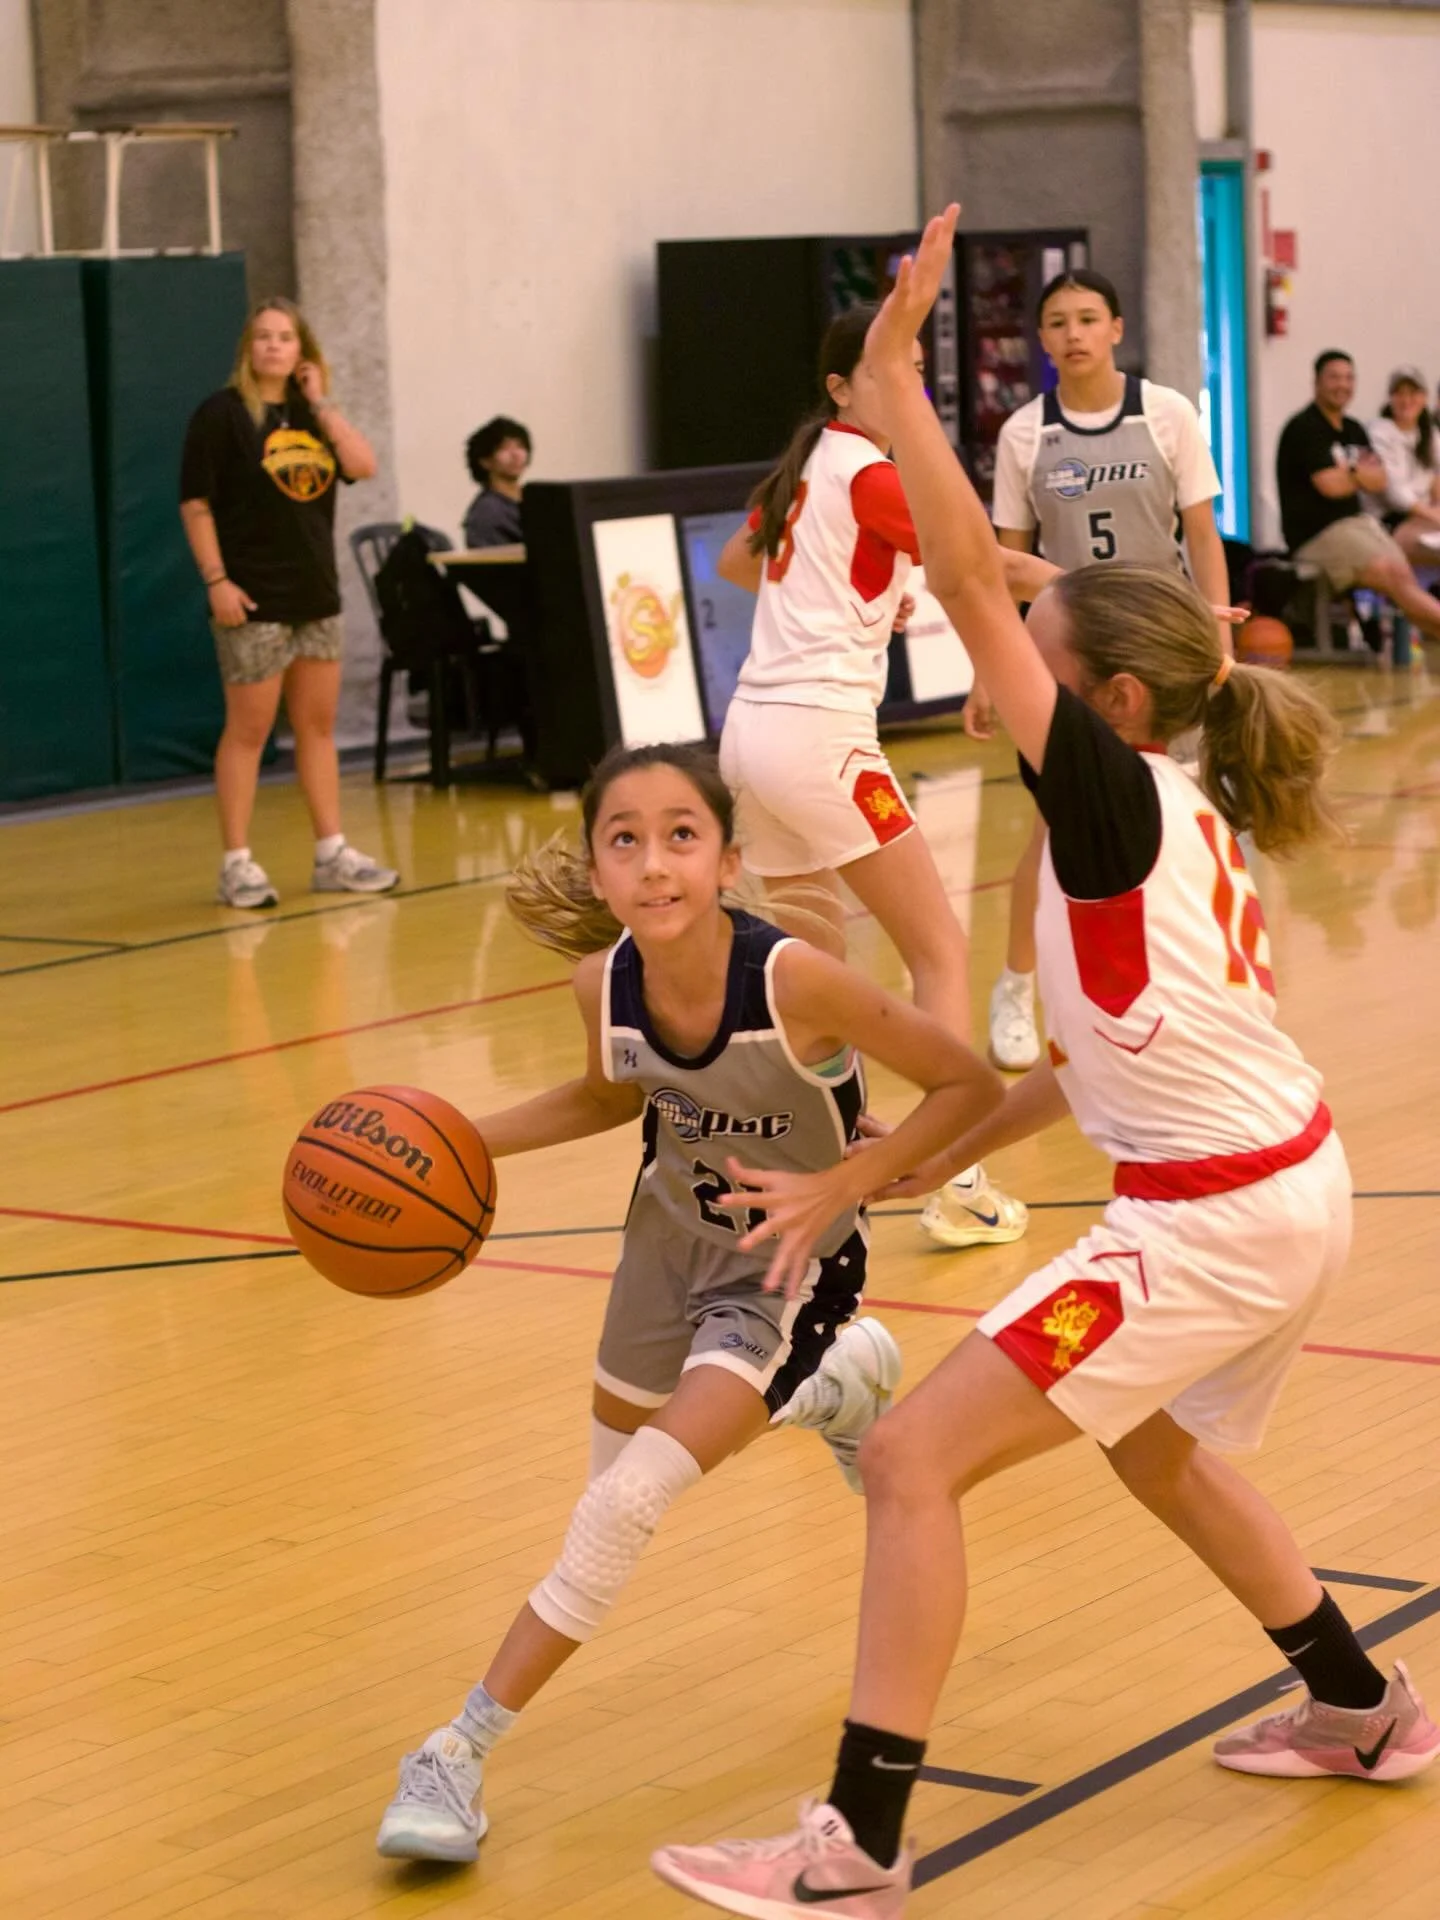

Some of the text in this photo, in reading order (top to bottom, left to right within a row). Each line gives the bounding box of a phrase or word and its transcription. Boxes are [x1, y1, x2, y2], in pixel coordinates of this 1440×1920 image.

[1087, 510, 1118, 561] 5
[312, 1101, 433, 1182] Wilson
[290, 1159, 403, 1224] EVOLUTION
